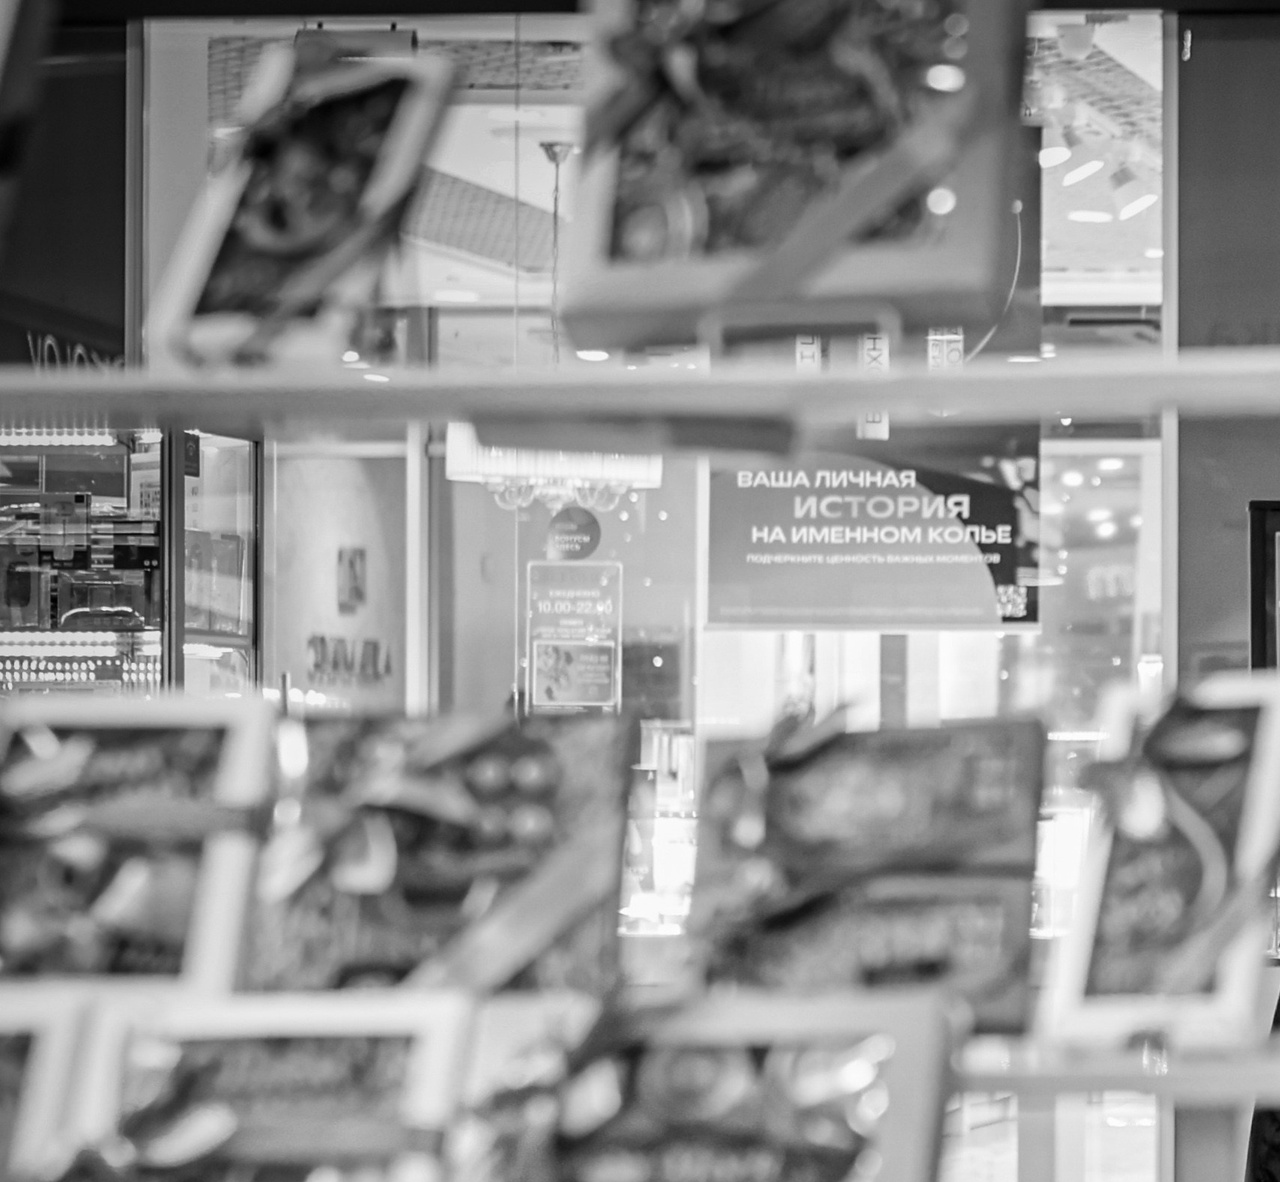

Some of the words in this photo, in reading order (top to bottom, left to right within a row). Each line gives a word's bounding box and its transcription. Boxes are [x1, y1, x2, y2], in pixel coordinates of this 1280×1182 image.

[737, 470, 809, 488] ВАША
[815, 470, 917, 489] ЛИЧНАЯ
[794, 494, 971, 519] ИСТОРИЯ
[752, 525, 787, 544] НА
[791, 525, 922, 544] ИМЕННОМ
[928, 524, 1012, 544] КОЛЬЕ
[746, 554, 824, 564] ПОДЧЕРКНИТЕ
[826, 554, 885, 565] ЦЕННОСТЬ
[936, 554, 1001, 564] МОМЕНТОВ
